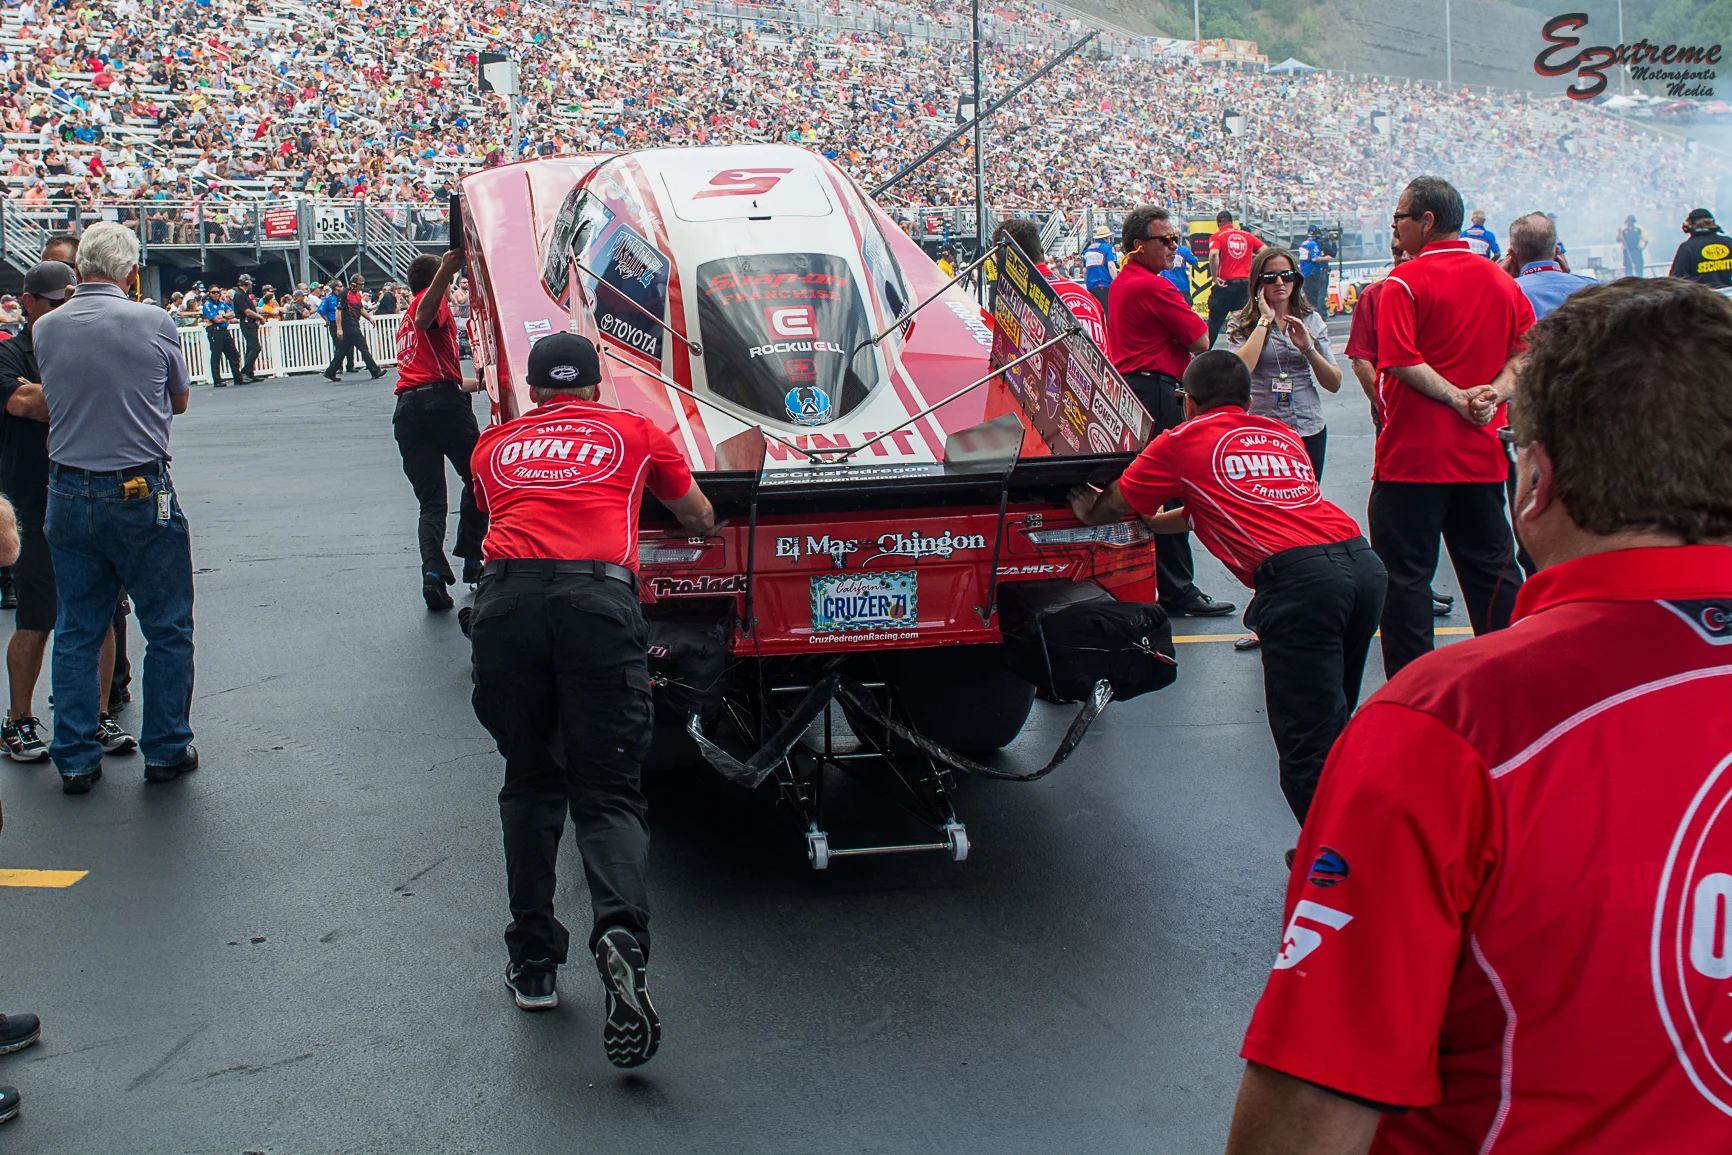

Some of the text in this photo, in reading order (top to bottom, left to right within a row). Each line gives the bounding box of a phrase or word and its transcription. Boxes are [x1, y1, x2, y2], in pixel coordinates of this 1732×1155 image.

[705, 272, 847, 296] Snap-on
[722, 289, 841, 306] FRANCHISE
[1066, 300, 1092, 313] SNAP-ON
[1022, 303, 1043, 343] MSD
[612, 317, 658, 355] TOYOTA
[749, 341, 845, 358] ROCKWELL
[1068, 355, 1091, 395] Strange
[1102, 369, 1119, 407] 3M
[500, 439, 612, 467] OWN IT
[766, 430, 916, 461] WN IT
[1240, 435, 1289, 451] SNAP-ON
[512, 466, 581, 479] FRANCHISE
[769, 467, 929, 479] @CruzPedregon
[1224, 454, 1312, 483] OWN IT
[1252, 483, 1311, 500] FRANCHISE
[775, 530, 987, 563] El Mas Chingon
[996, 563, 1070, 576] CAMRY
[823, 594, 907, 620] CRUZER 71
[809, 632, 919, 644] CruzPedregonRacing.com
